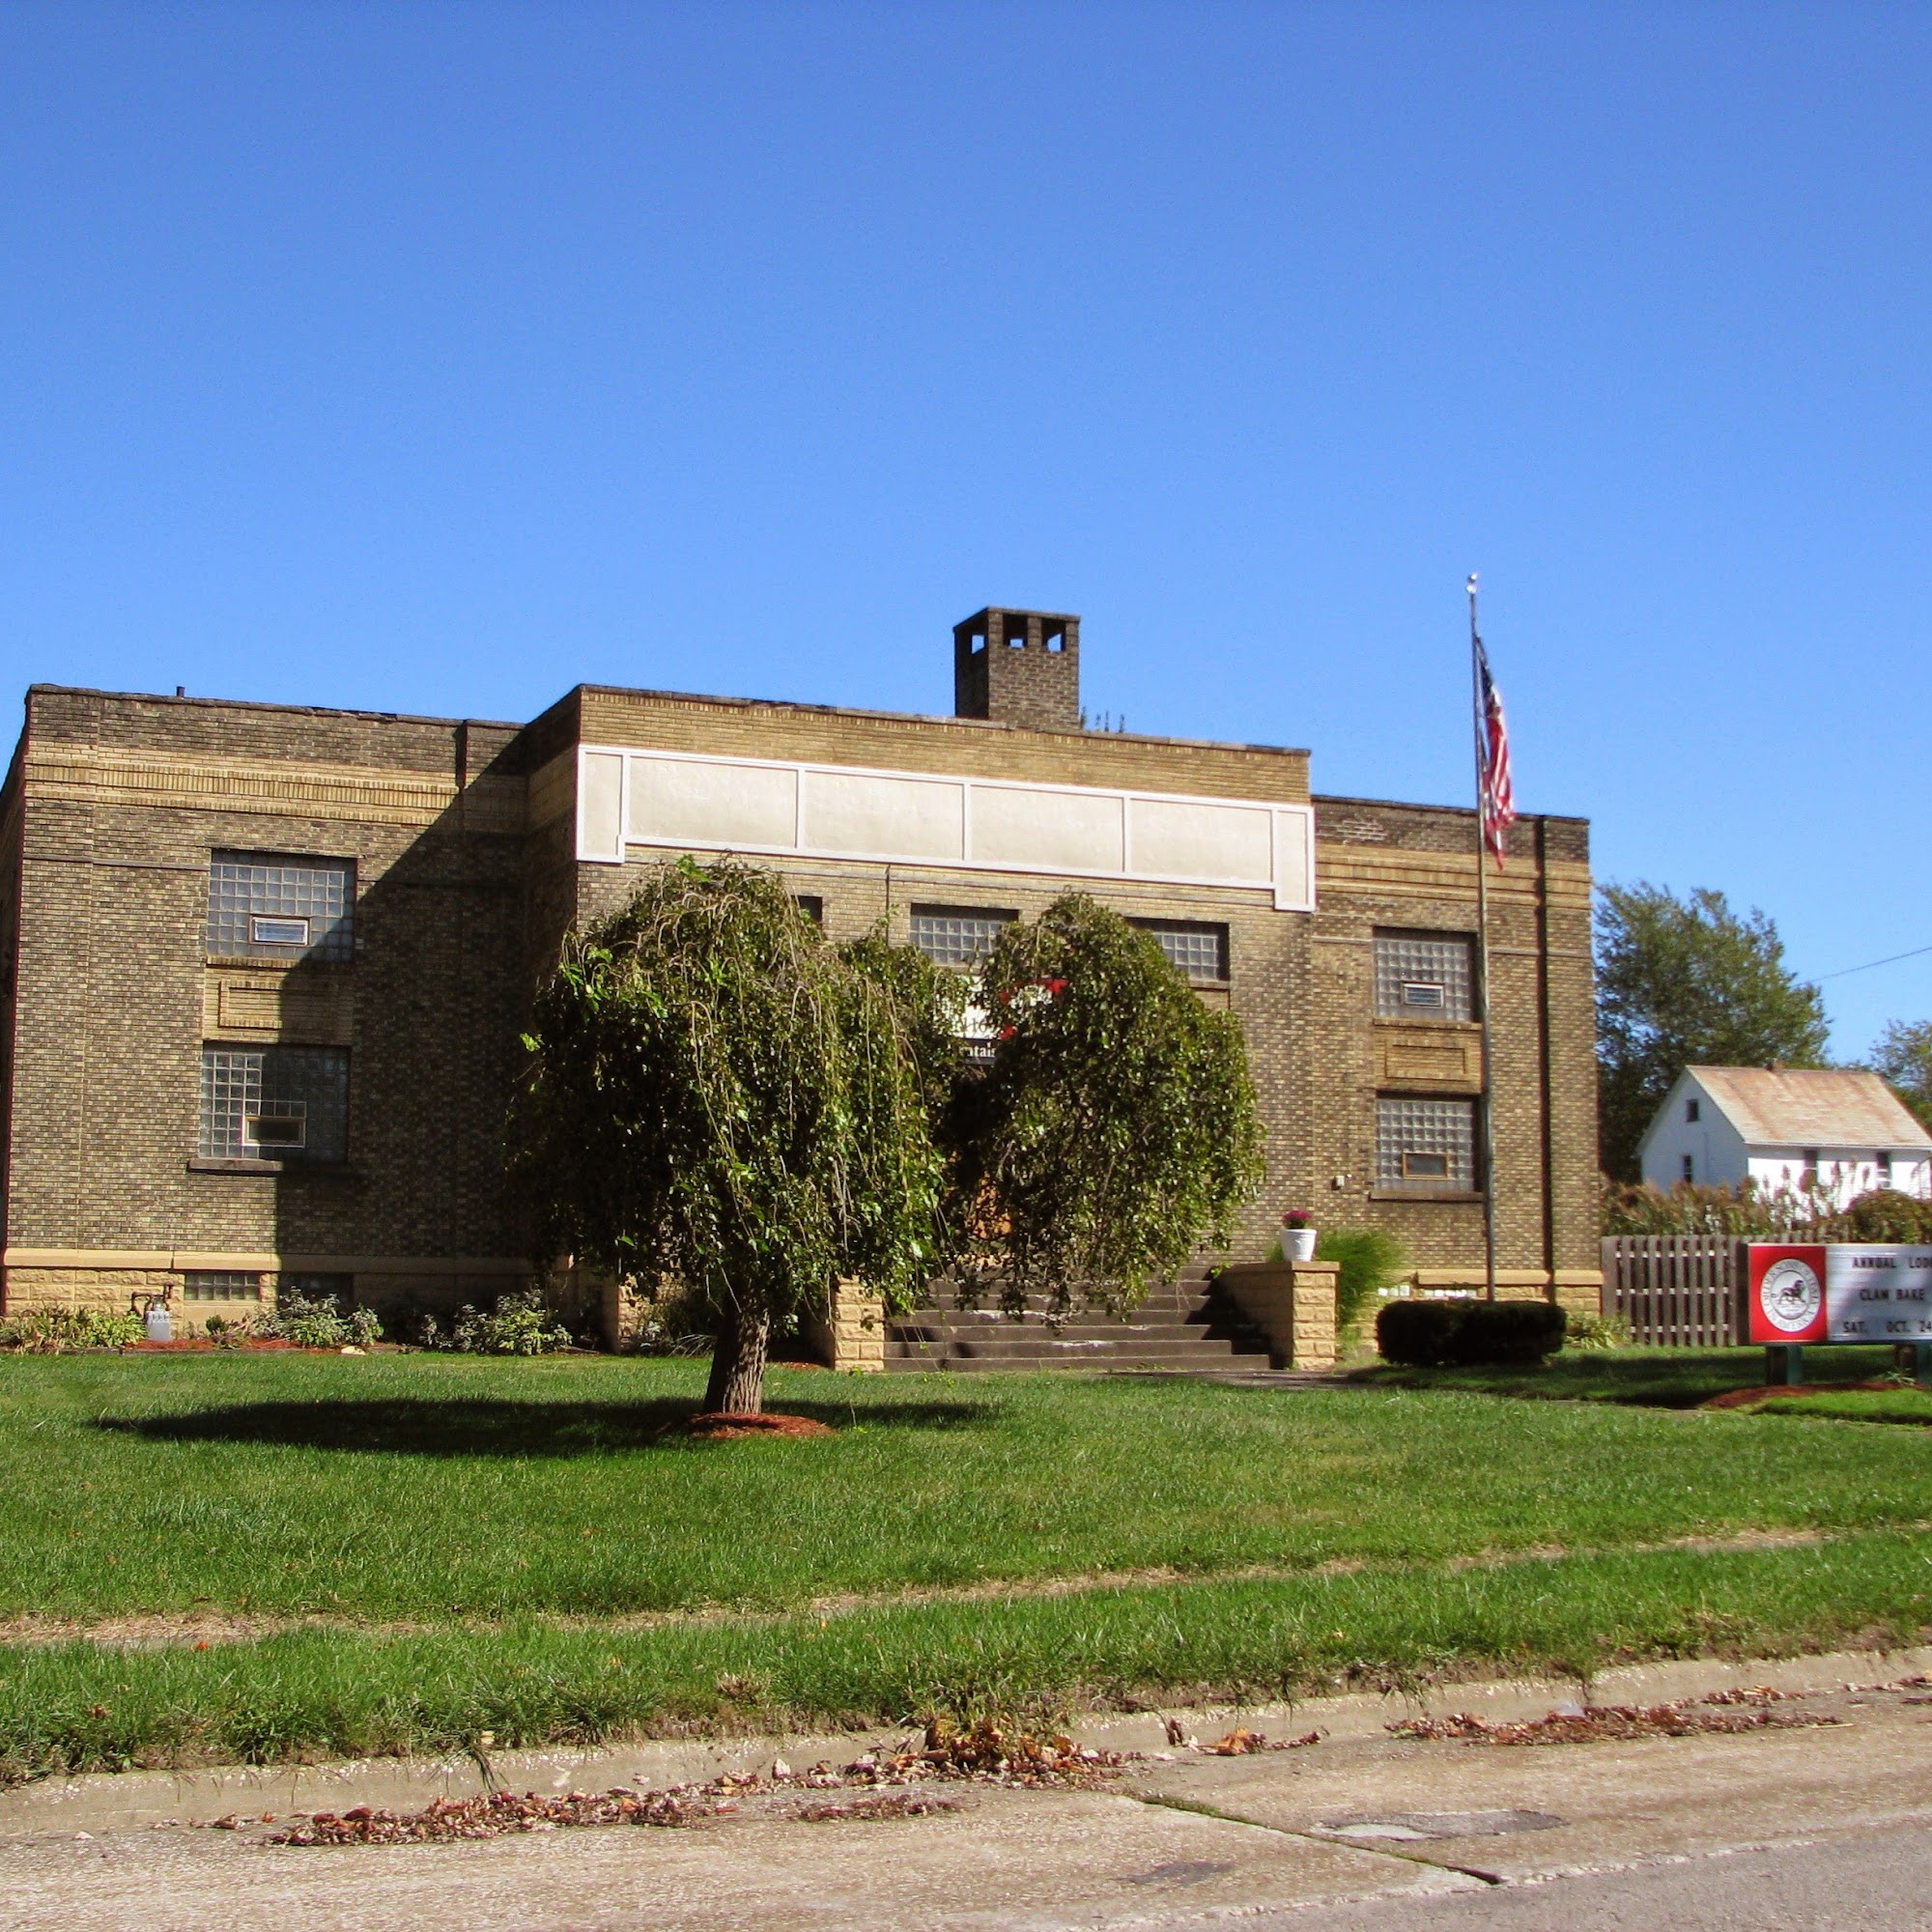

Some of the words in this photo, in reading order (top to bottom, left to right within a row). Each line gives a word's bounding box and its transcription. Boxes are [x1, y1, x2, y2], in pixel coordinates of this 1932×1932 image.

[1852, 1257, 1896, 1268] ANNUAL
[1909, 1257, 1932, 1268] LOD
[1860, 1289, 1889, 1300] CLAM
[1895, 1289, 1924, 1300] BAKE
